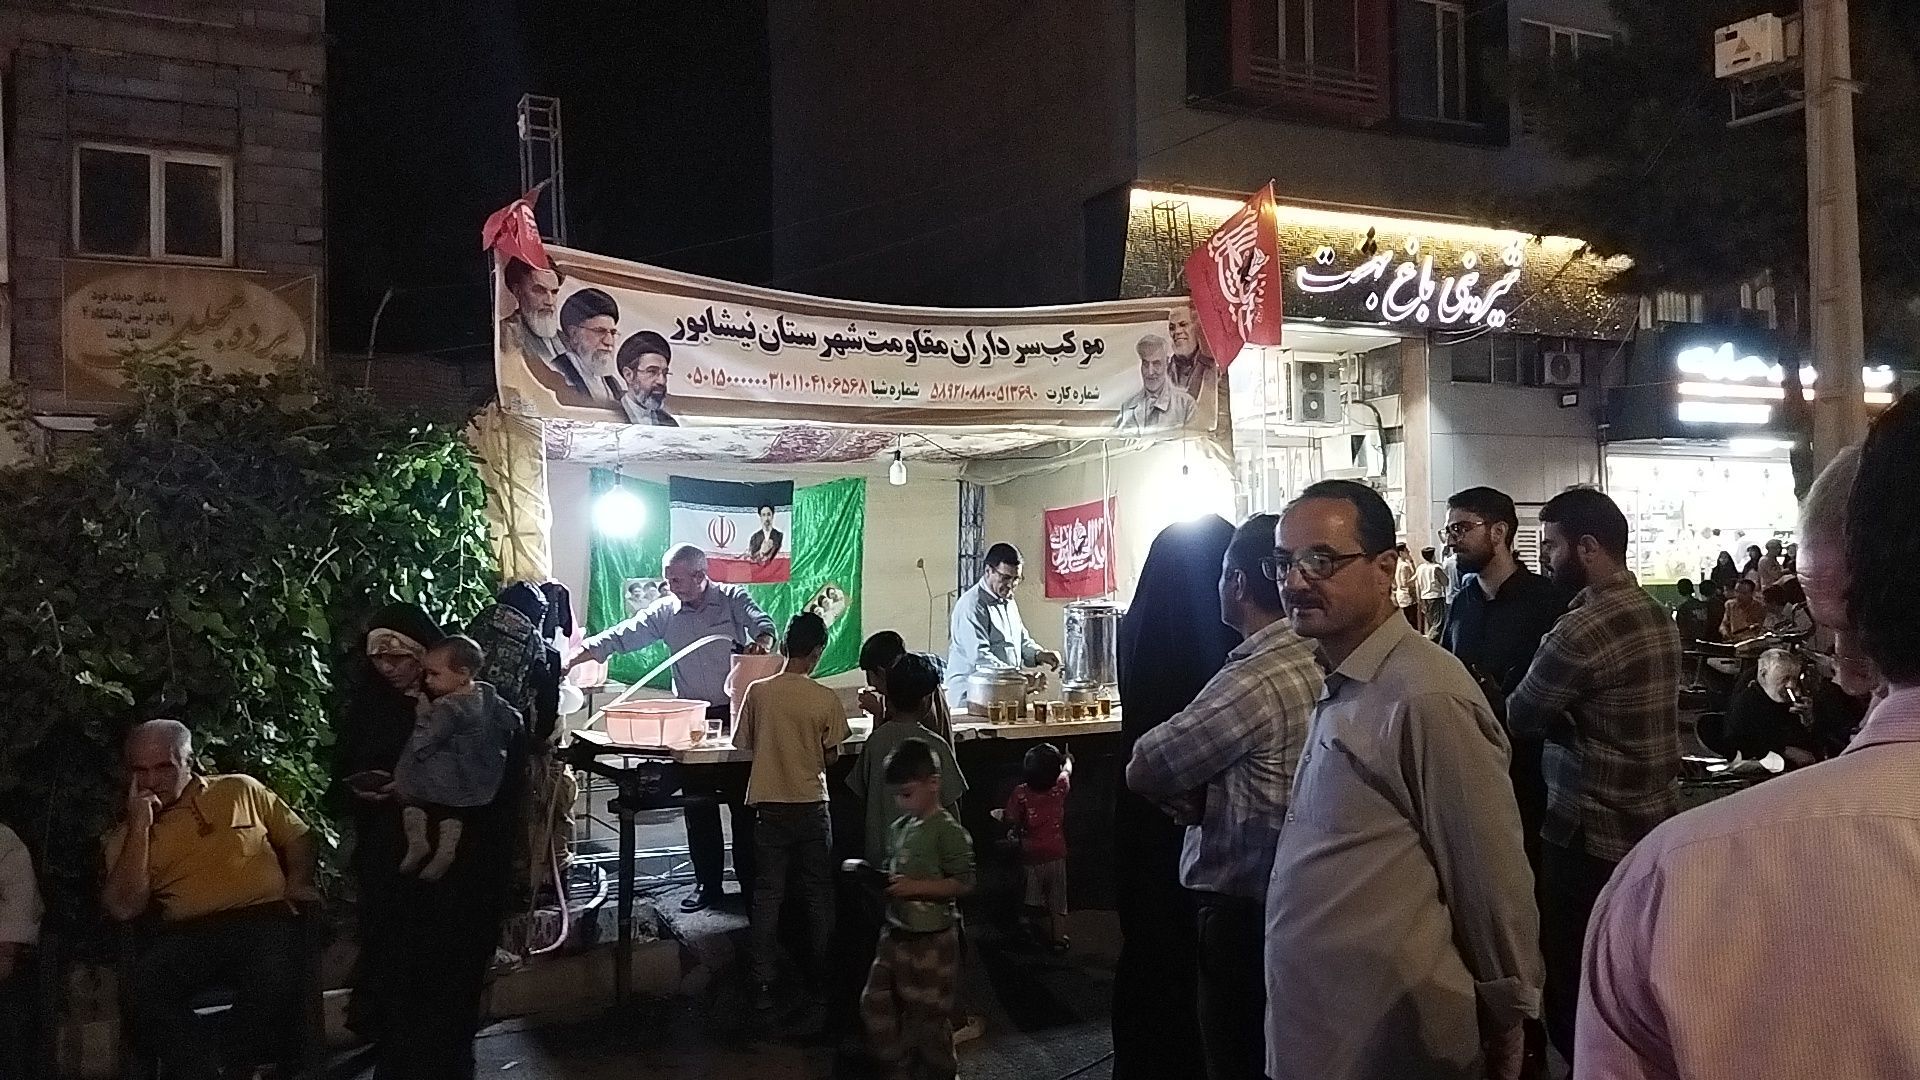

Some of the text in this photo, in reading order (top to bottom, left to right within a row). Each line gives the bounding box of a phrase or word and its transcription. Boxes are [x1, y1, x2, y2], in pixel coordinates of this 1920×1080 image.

[1296, 226, 1394, 311] بهشت
[1381, 236, 1436, 323] باغ
[1437, 238, 1524, 328] شیرینی
[669, 305, 1105, 365] موکب سرداران مقاومت شهرستان نیشابور
[870, 379, 889, 399] شبا
[889, 380, 920, 401] شماره
[1046, 386, 1072, 404] کارت
[1073, 384, 1100, 404] شماره
